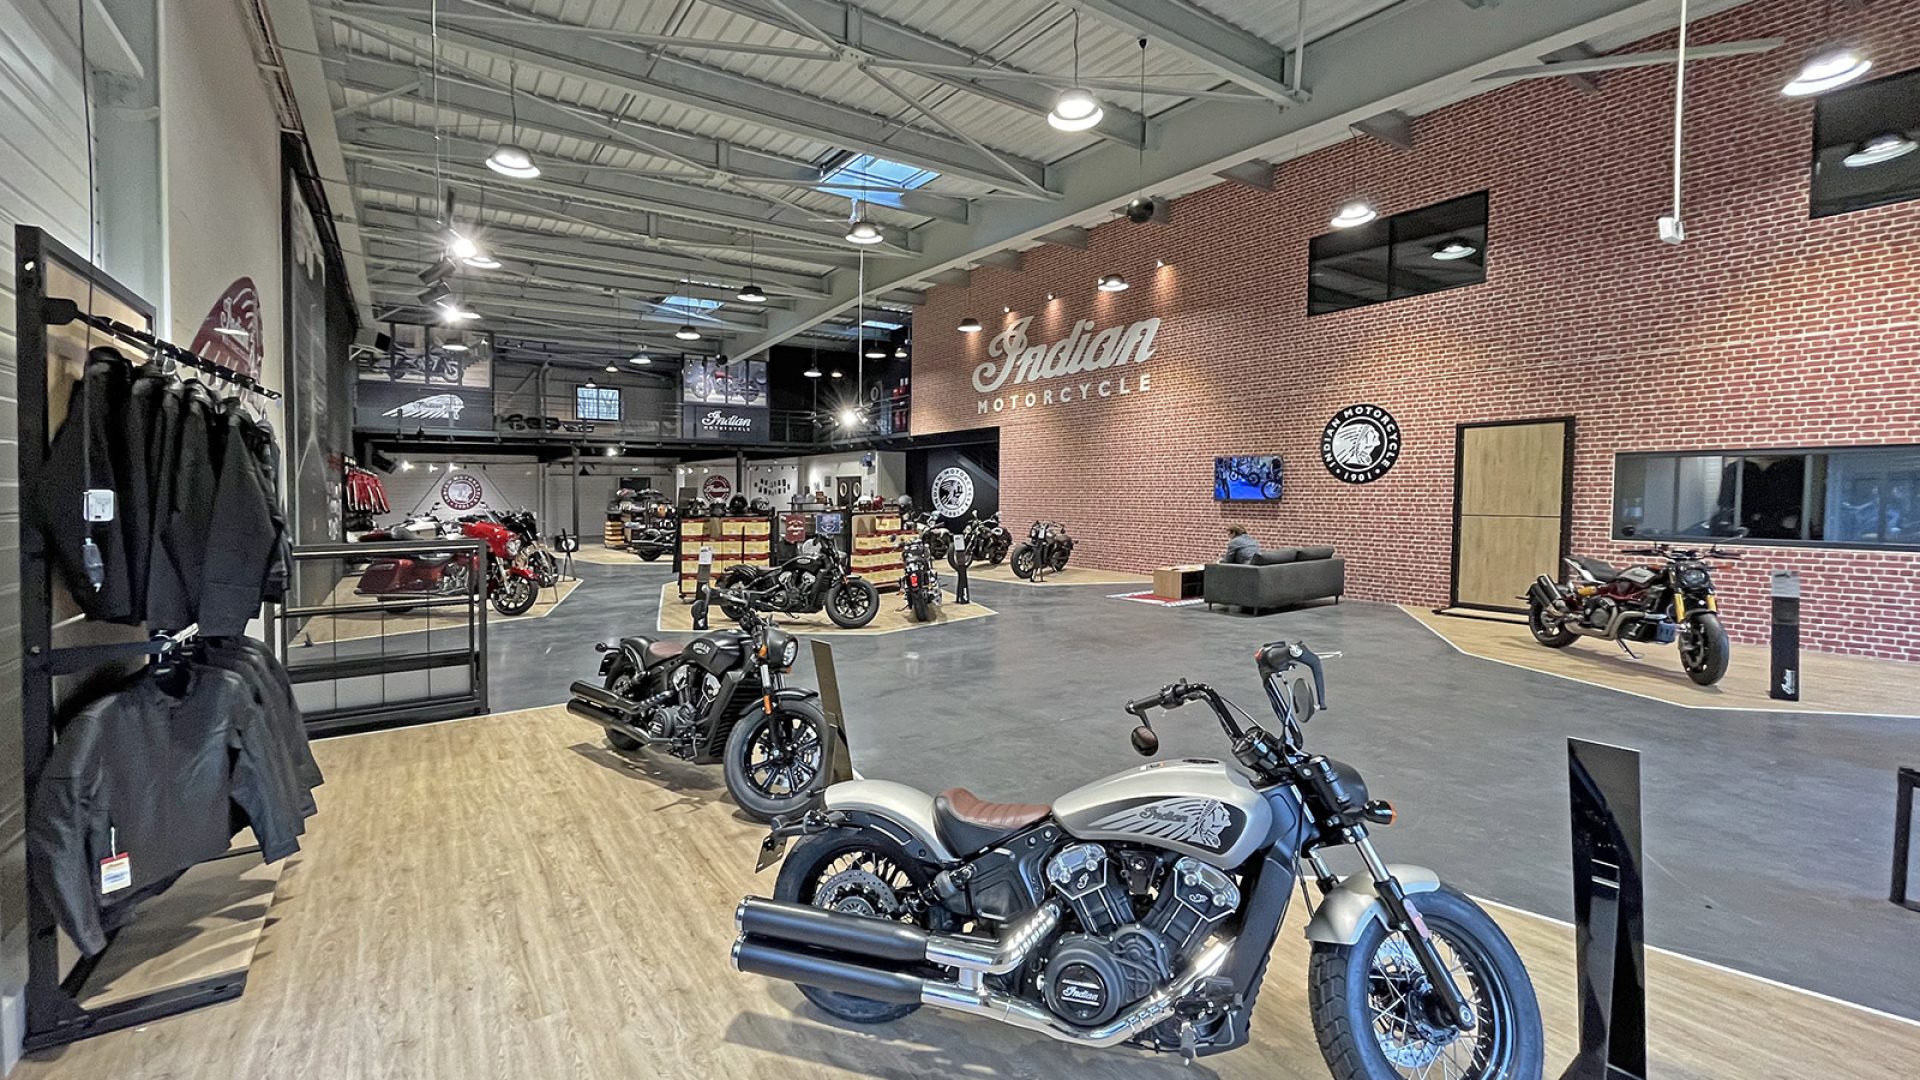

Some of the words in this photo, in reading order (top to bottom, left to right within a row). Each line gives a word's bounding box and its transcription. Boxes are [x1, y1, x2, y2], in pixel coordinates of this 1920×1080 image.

[972, 316, 1161, 392] Indian
[978, 374, 1150, 414] MOTORCYCLE
[701, 410, 751, 426] Indian
[1323, 418, 1340, 468] INDIAN
[1343, 406, 1398, 467] MOTORCYCLE
[1343, 472, 1372, 481] 1901
[1140, 806, 1188, 822] Indian
[1062, 985, 1099, 1001] Indian
